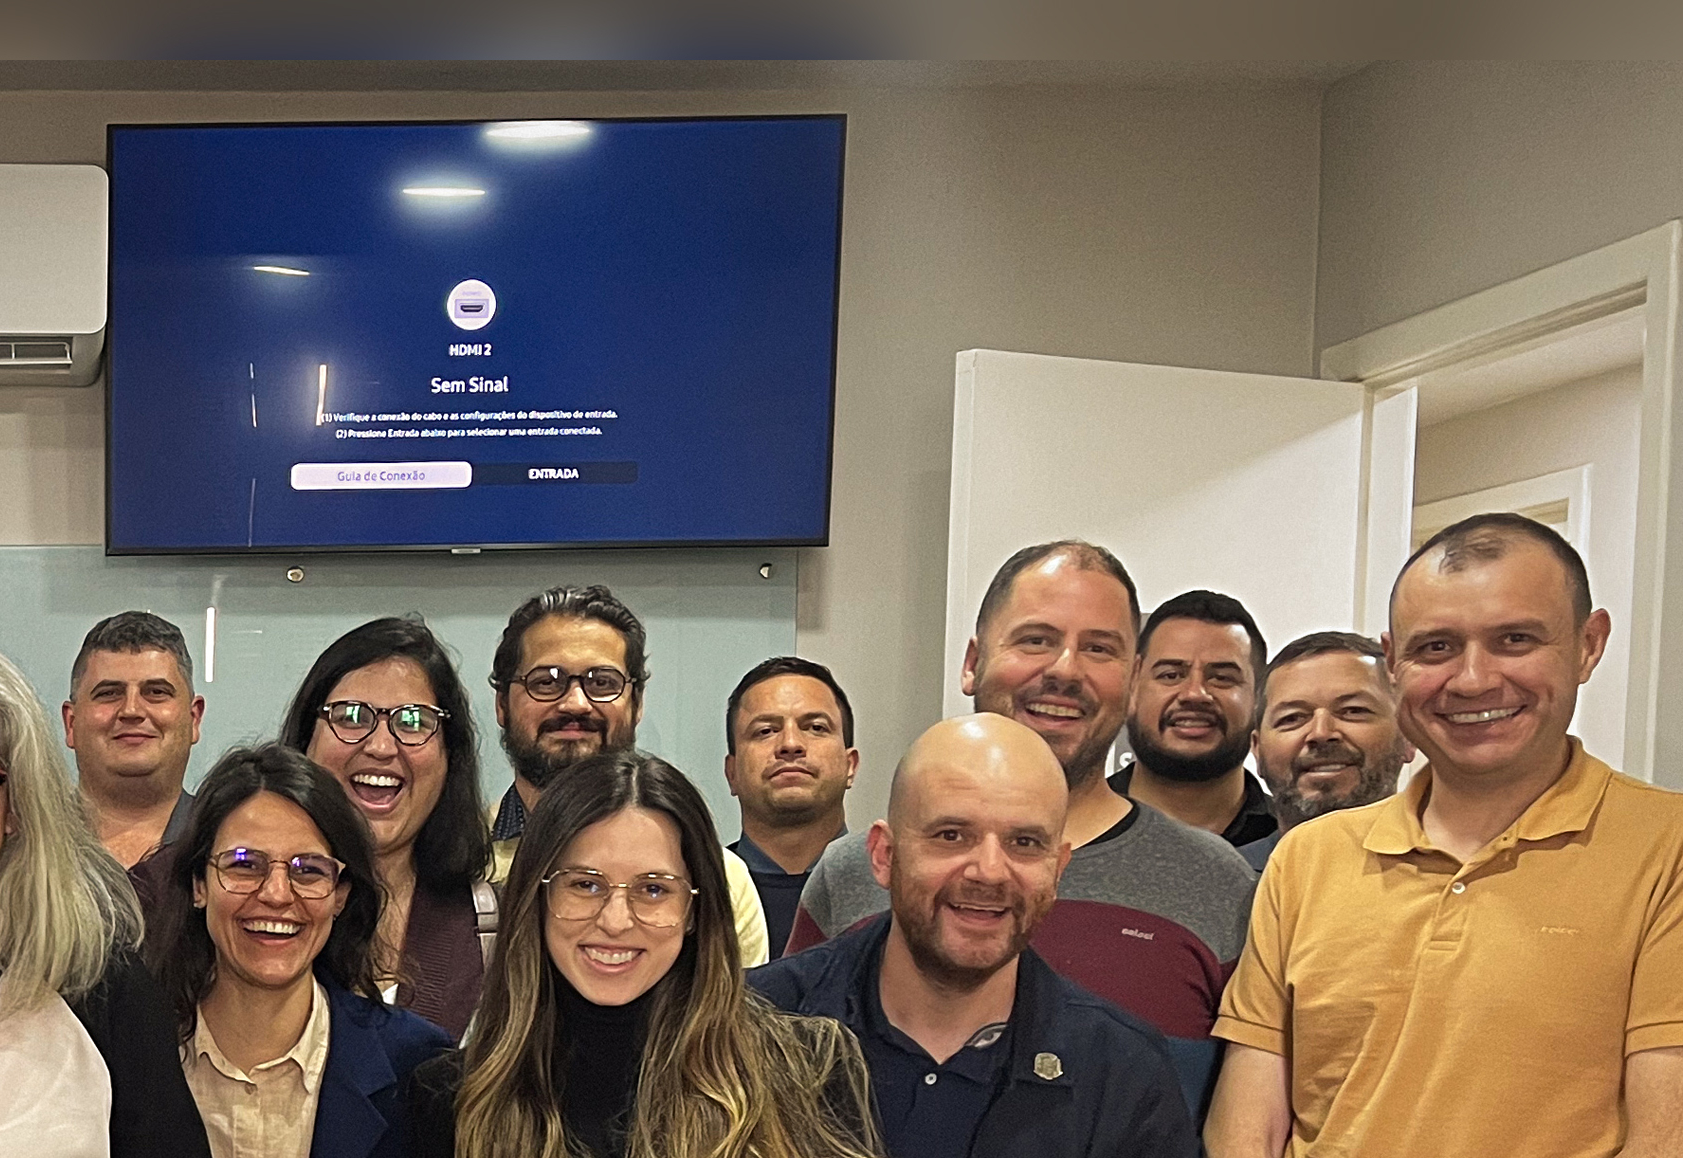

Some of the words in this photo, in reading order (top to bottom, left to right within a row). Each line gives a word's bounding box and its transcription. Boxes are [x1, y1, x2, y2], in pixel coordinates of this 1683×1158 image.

[448, 343, 483, 357] HDMI
[484, 343, 492, 356] 2
[430, 377, 466, 394] Sem
[469, 375, 509, 393] Sinal
[321, 412, 333, 422] (1)
[334, 412, 370, 423] Verifique
[377, 411, 410, 421] conexão
[423, 412, 442, 421] cabo
[460, 410, 515, 421] configurações
[528, 410, 572, 420] dispositivo
[584, 409, 618, 419] entrada.
[336, 429, 347, 439] (2)
[348, 429, 387, 438] Pressione
[387, 428, 419, 438] Entrada
[420, 428, 446, 438] abaixo
[447, 429, 466, 438] para
[466, 427, 508, 437] selecionar
[508, 428, 526, 436] uma
[527, 426, 559, 436] entrada
[559, 426, 603, 436] conectada.
[337, 469, 361, 483] Guia
[364, 470, 377, 482] de
[379, 469, 426, 482] Conexão
[528, 467, 579, 480] ENTRADA
